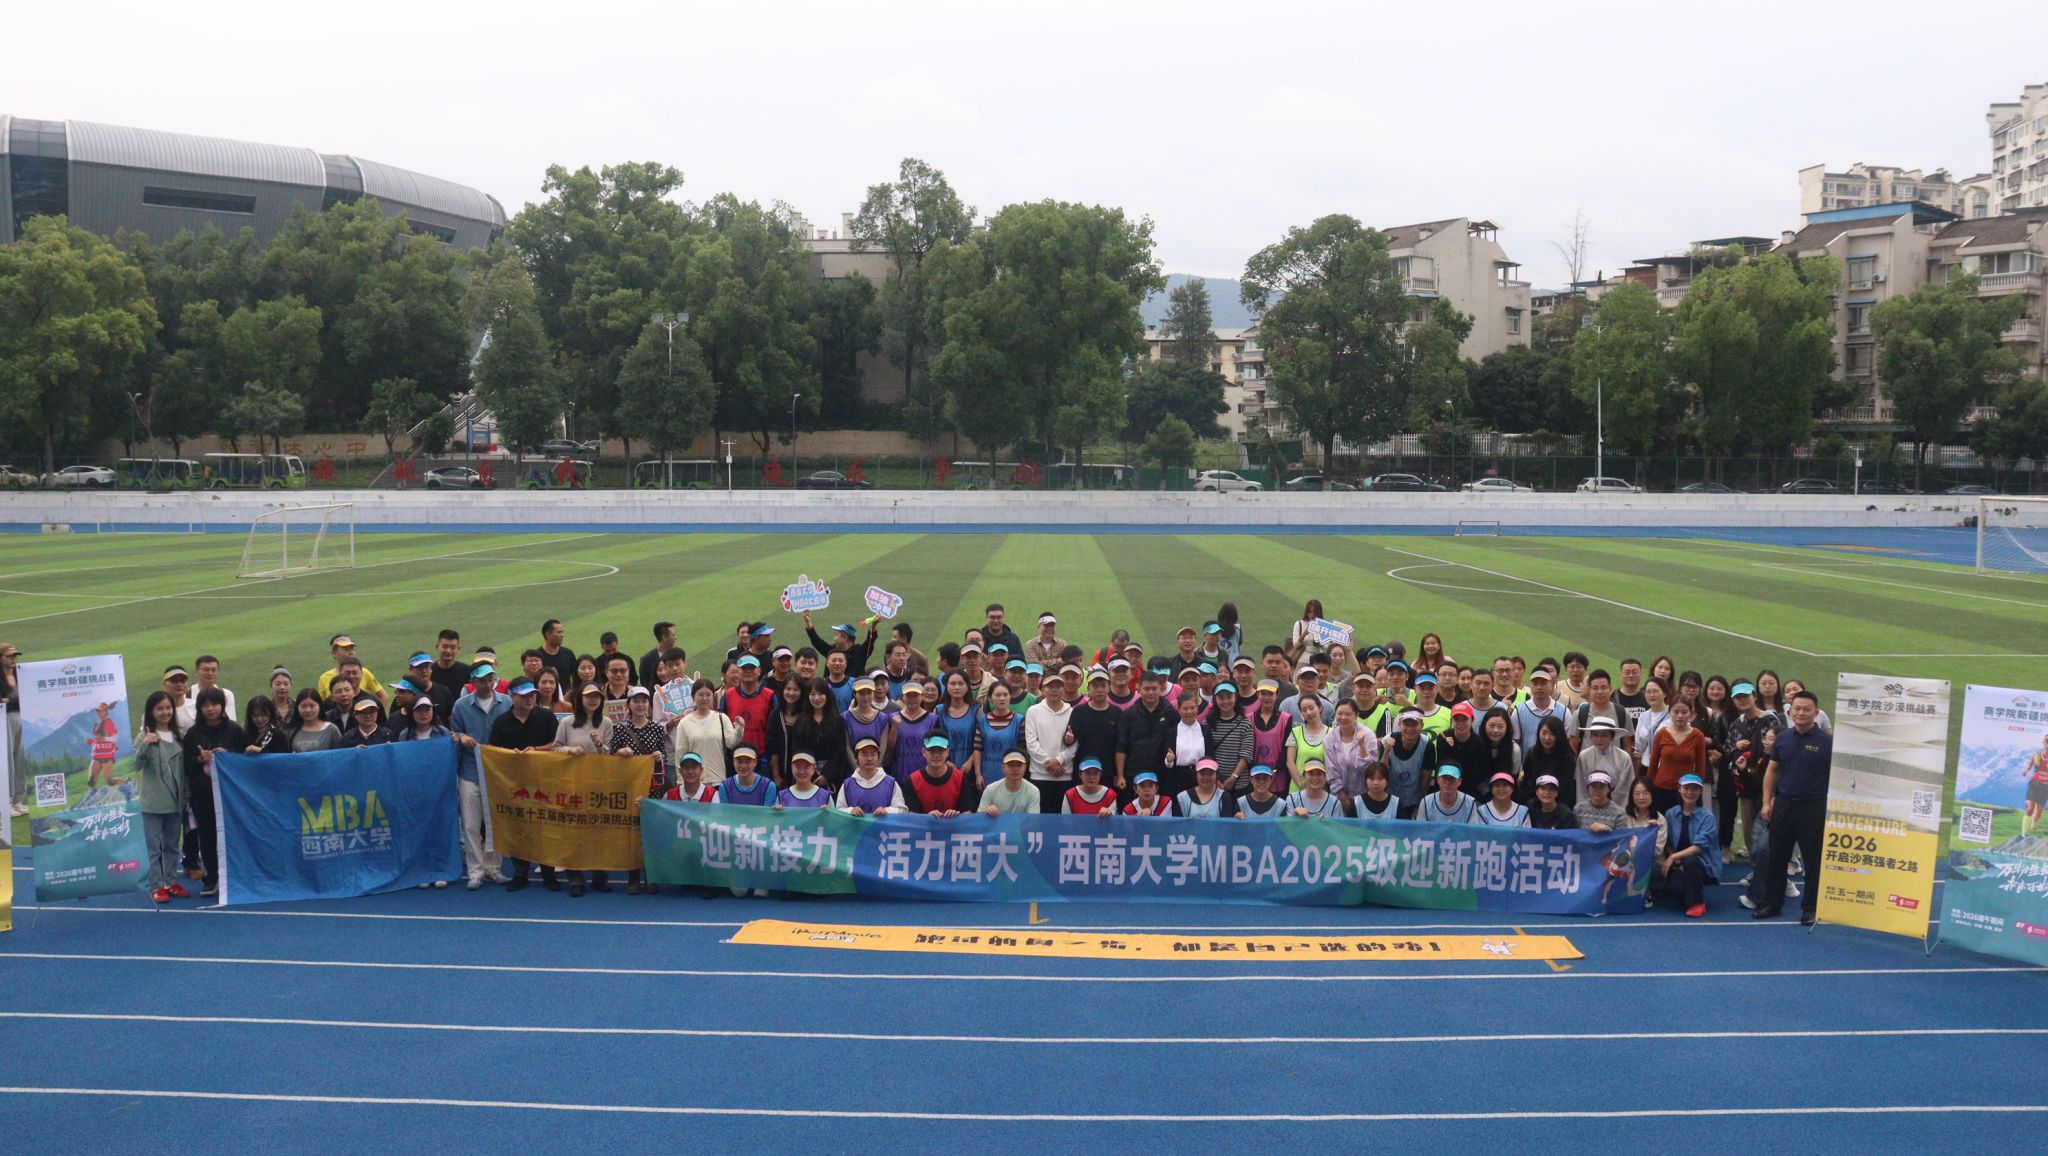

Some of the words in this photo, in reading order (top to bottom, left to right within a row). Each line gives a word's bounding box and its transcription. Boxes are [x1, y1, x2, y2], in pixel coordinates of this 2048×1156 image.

[37, 672, 115, 690] 商学院新疆挑战赛
[1847, 698, 1936, 715] 商学院沙漠挑战赛
[556, 791, 582, 808] 红牛
[590, 791, 627, 809] 沙15
[1830, 801, 1882, 815] DESERT
[297, 790, 389, 834] MBA
[496, 804, 641, 826] 红牛第十五届商学院沙漠挑战赛
[1827, 813, 1909, 836] ADVENTURE
[301, 827, 392, 856] 西南大学
[1827, 833, 1877, 852] 2026
[1825, 851, 1919, 873] 开启沙赛强者之路
[1838, 887, 1876, 900] 五一期间
